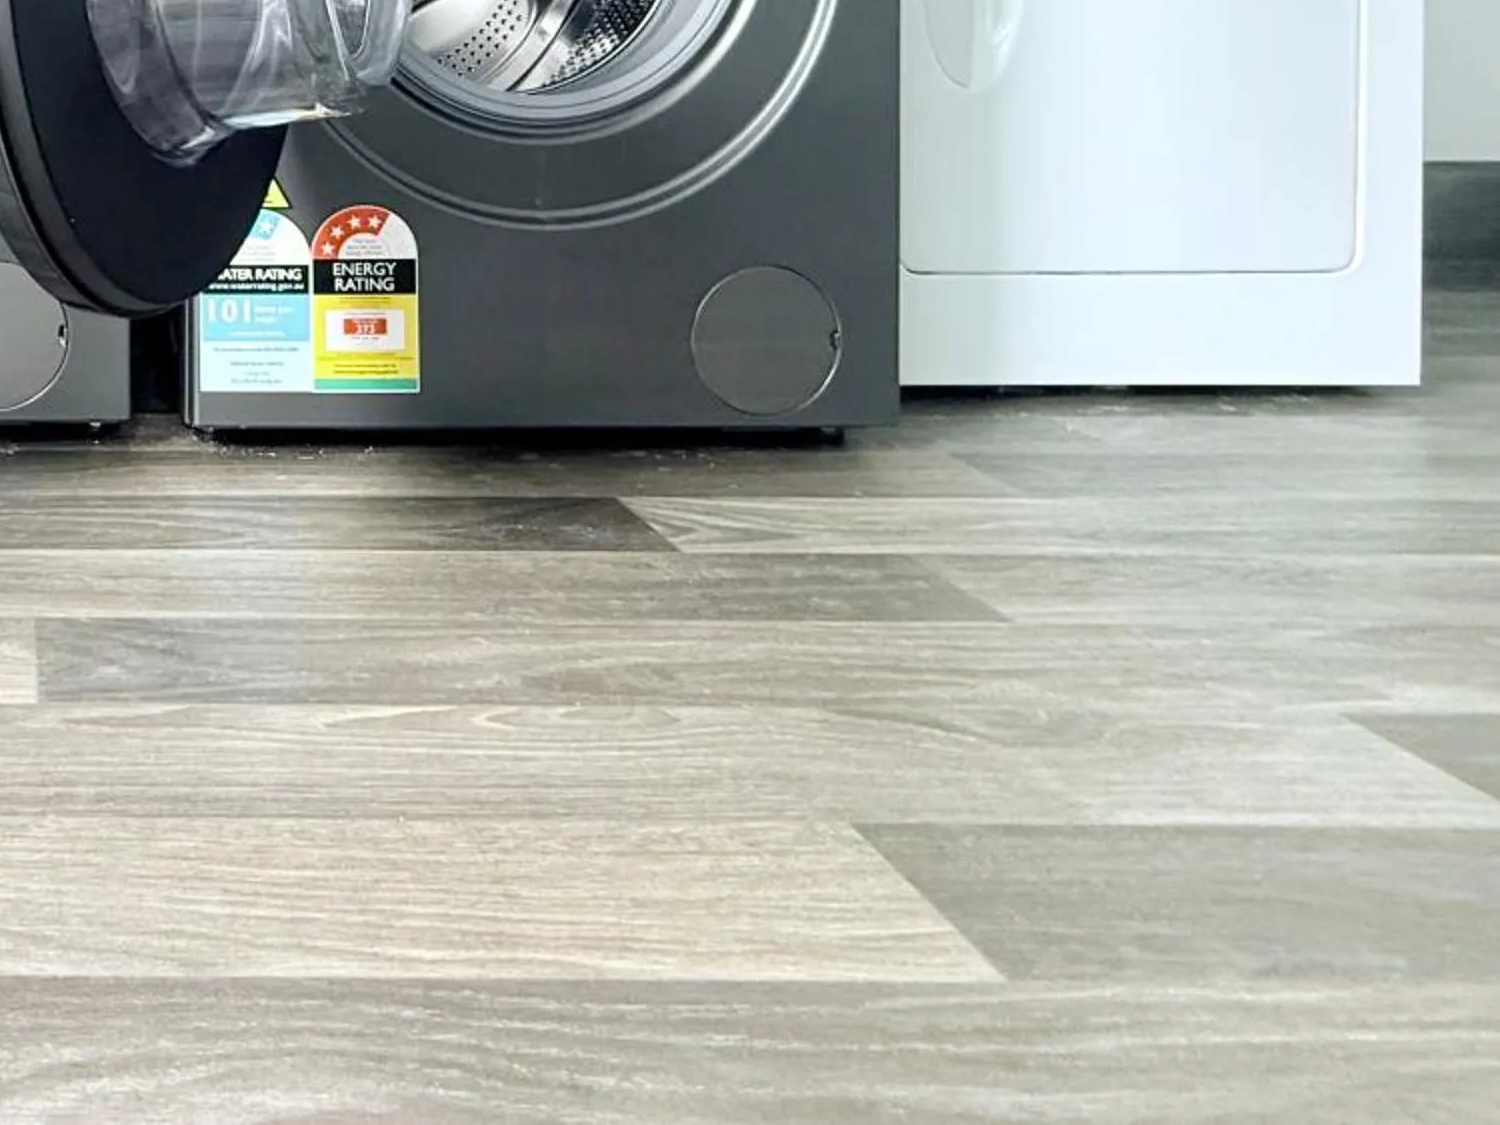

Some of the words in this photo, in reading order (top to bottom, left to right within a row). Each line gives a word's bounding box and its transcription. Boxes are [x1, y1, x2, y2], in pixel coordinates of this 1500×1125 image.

[217, 268, 252, 280] ATER
[255, 268, 302, 280] RATING
[332, 262, 396, 276] ENERGY
[334, 278, 395, 291] RATING
[207, 298, 251, 323] 101
